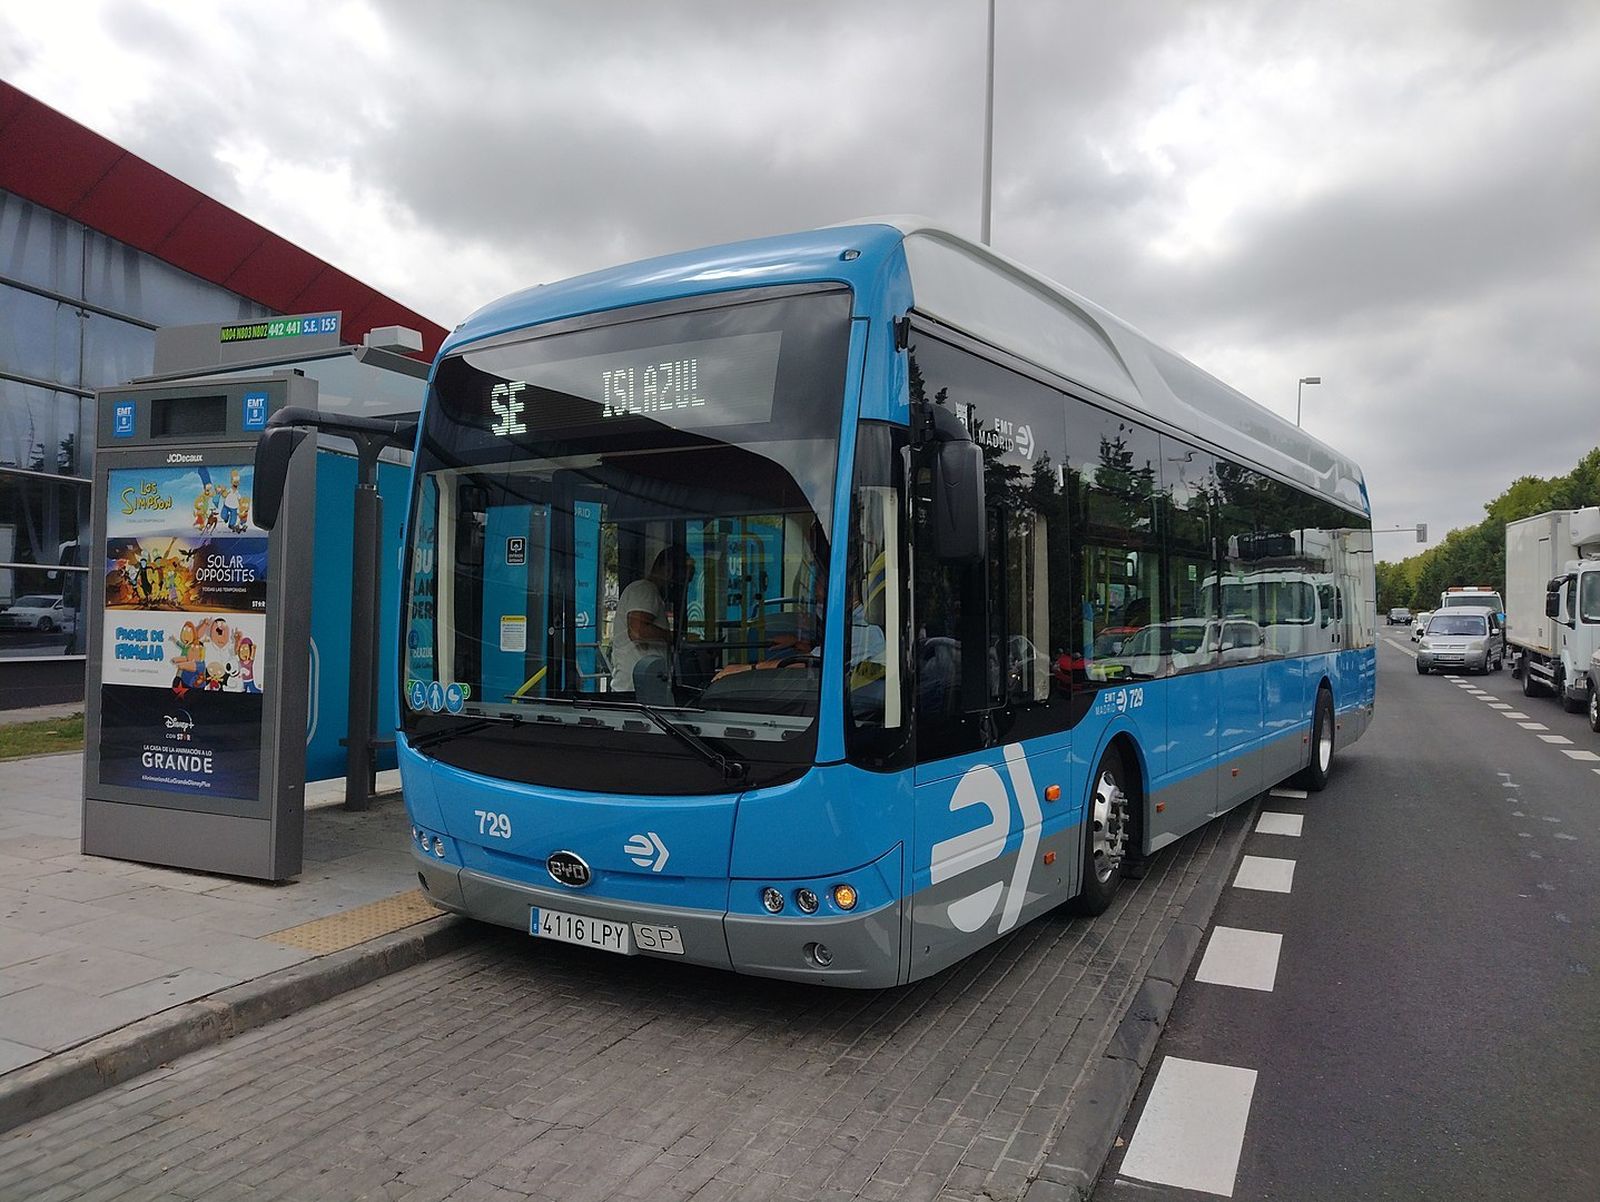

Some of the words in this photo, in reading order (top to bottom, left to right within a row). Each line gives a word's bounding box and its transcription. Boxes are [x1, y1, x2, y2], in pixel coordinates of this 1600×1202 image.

[269, 322, 284, 336] 442
[286, 321, 300, 334] 441
[304, 320, 318, 332] S.E.
[321, 318, 336, 331] 155
[248, 398, 264, 407] EMT
[491, 380, 526, 436] SE
[602, 359, 705, 418] ISLAZUL
[116, 407, 132, 415] EMT
[994, 418, 1013, 436] EMT
[978, 430, 1014, 452] MADRID
[166, 454, 203, 463] JCDecaux
[208, 554, 244, 568] SOLAR
[196, 568, 254, 582] OPPOSITES
[150, 630, 164, 642] DE
[463, 686, 468, 694] 3
[1104, 692, 1116, 702] EMT
[1130, 688, 1144, 708] 729
[142, 752, 213, 774] GRANDE
[474, 810, 512, 838] 729
[550, 861, 585, 880] BYD
[543, 912, 585, 940] 4116
[591, 921, 624, 948] LPY
[640, 928, 674, 948] SP
